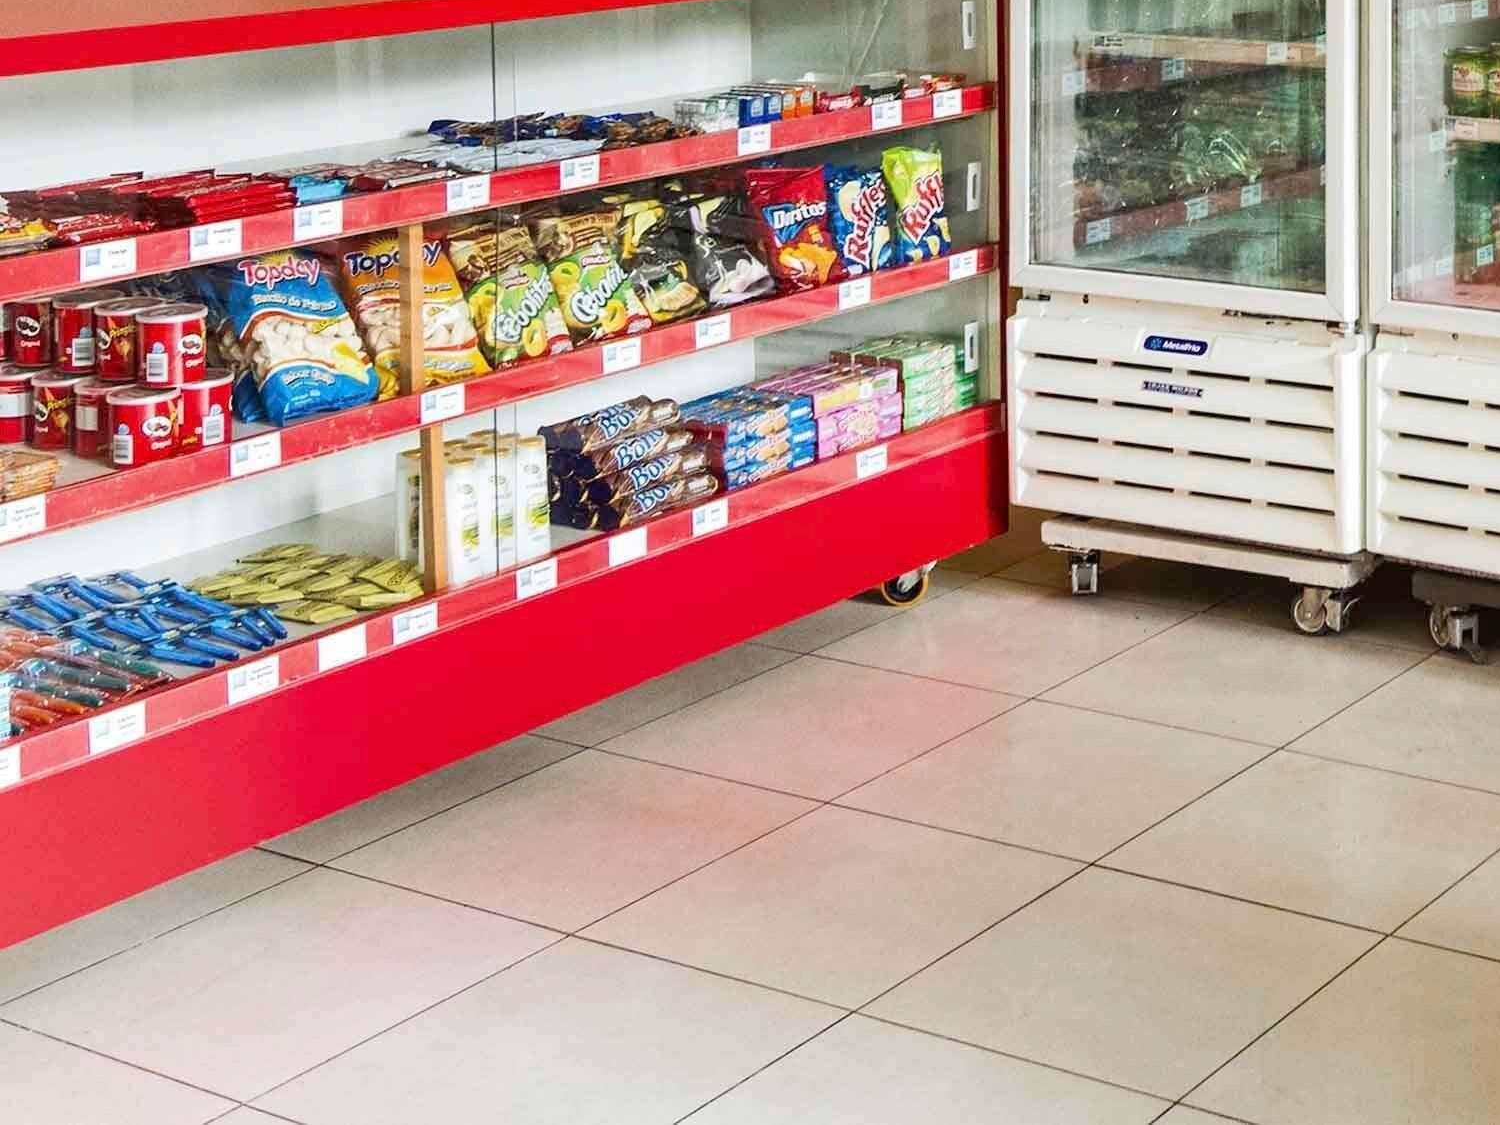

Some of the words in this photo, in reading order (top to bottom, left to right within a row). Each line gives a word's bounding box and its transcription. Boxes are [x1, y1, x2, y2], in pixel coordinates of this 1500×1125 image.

[773, 202, 827, 229] Doritos
[238, 254, 320, 290] Topday
[1162, 339, 1202, 353] Metalfrio
